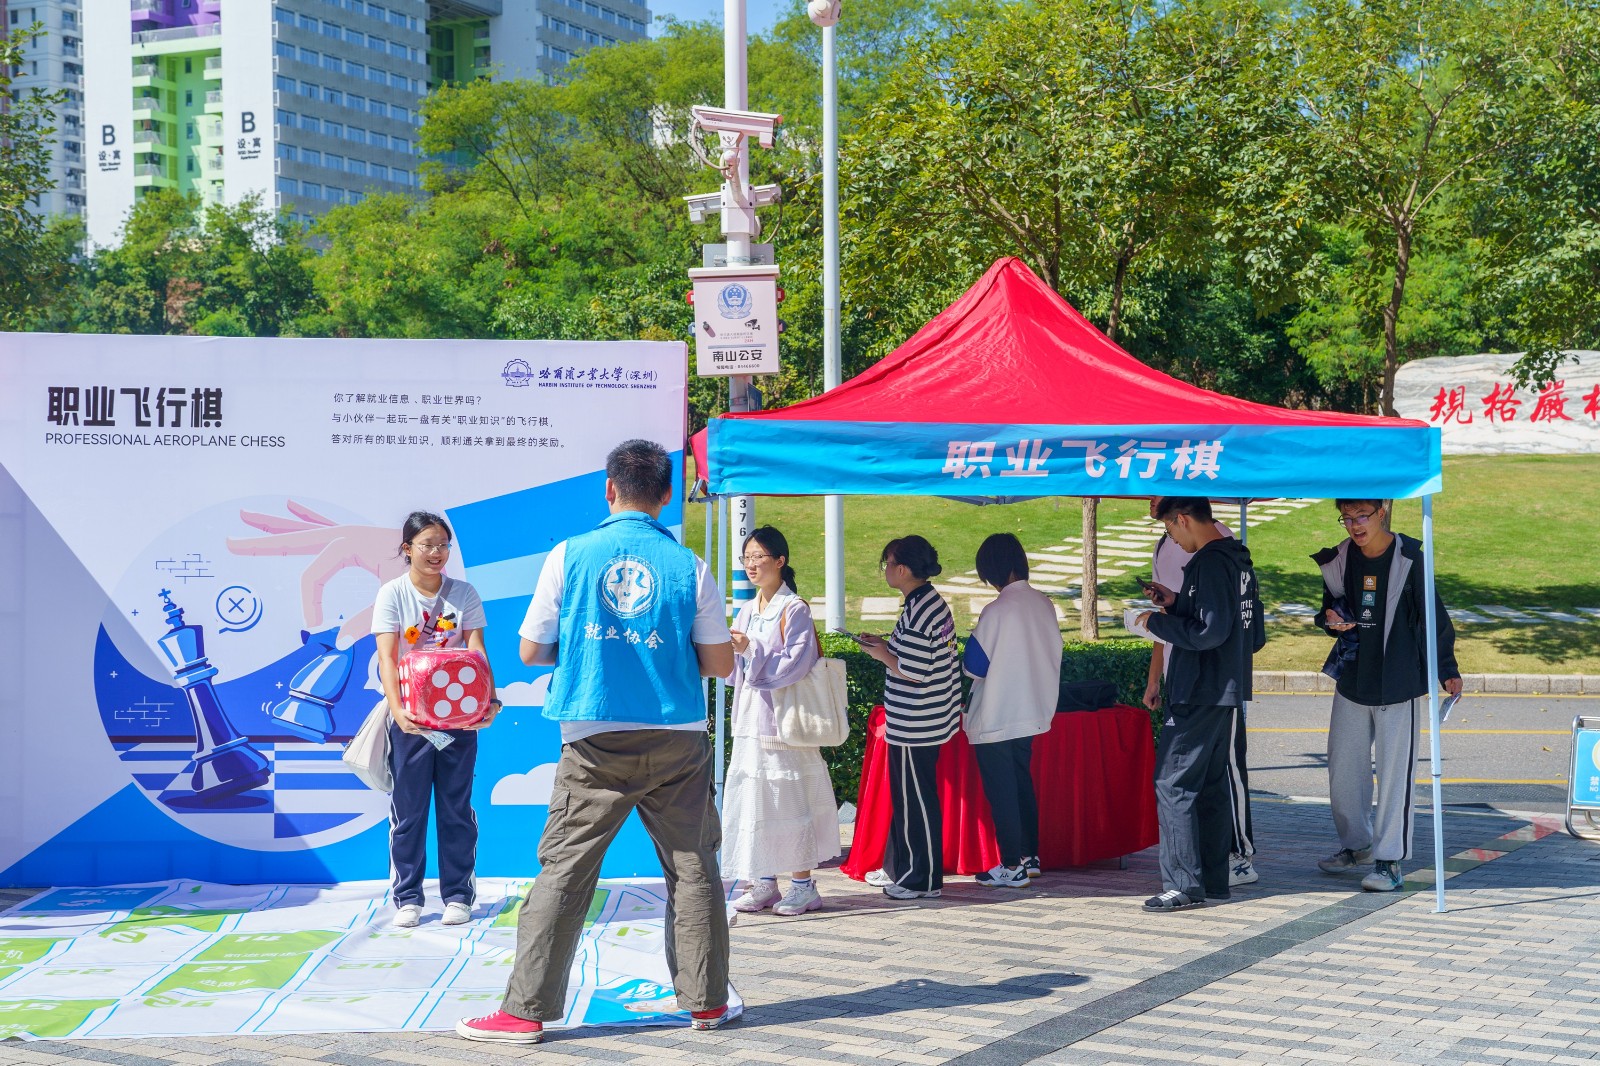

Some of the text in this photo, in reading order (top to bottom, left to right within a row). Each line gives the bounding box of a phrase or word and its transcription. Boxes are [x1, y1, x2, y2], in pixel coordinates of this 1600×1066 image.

[241, 111, 256, 133] B
[102, 124, 116, 146] B
[712, 349, 763, 363] 南山公安
[47, 385, 223, 428] 职业飞行棋
[45, 432, 286, 448] PROFESSIONAL AEROPLANE CHESS
[941, 439, 1225, 480] 职业飞行棋
[584, 622, 664, 650] 就业协会
